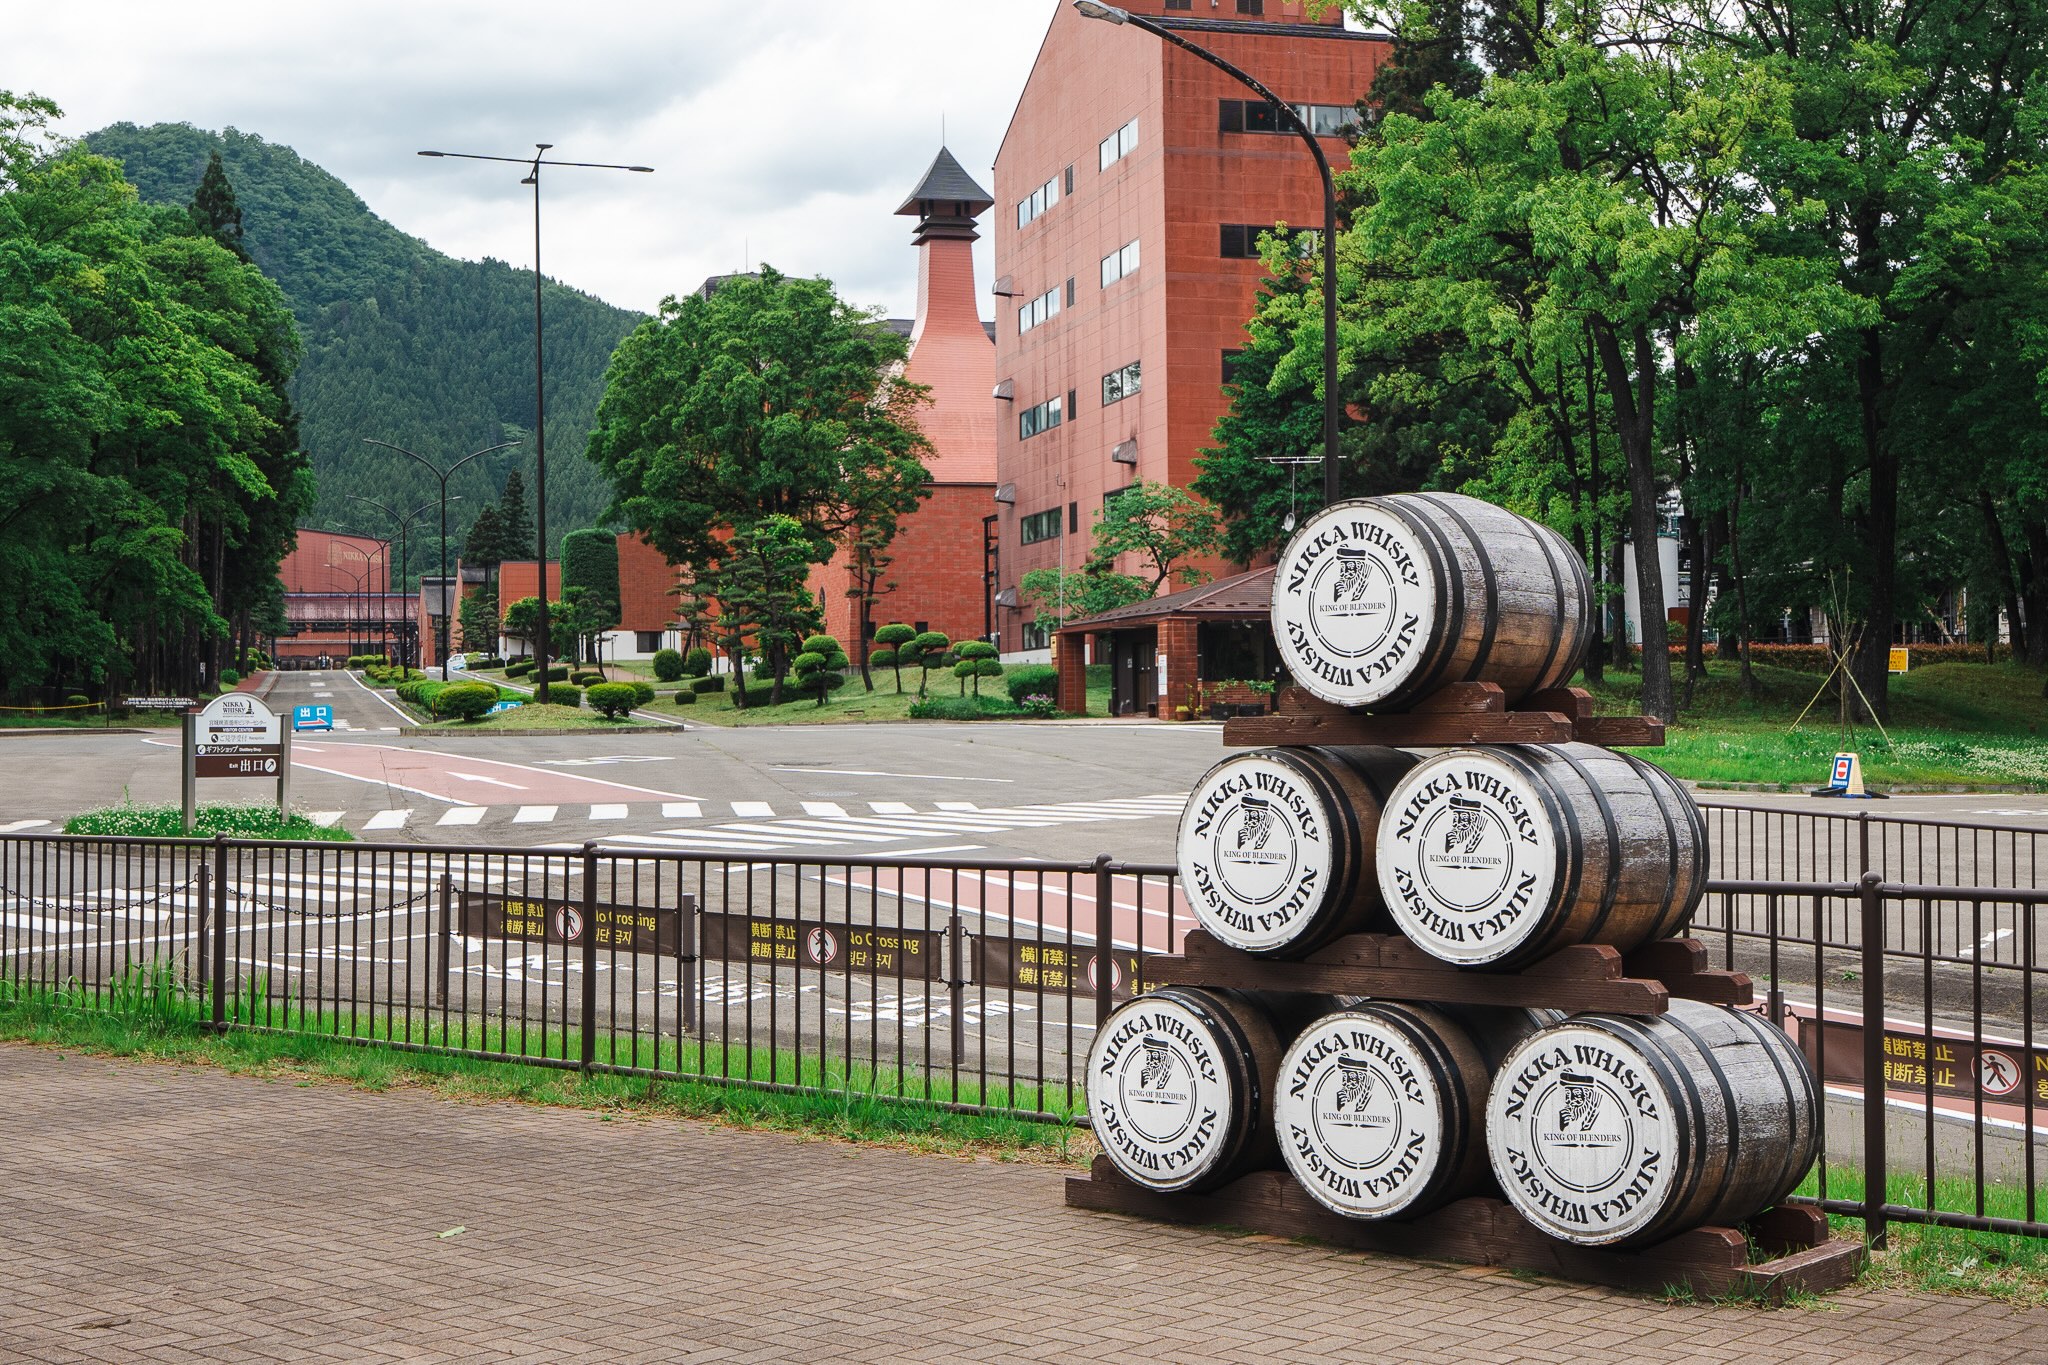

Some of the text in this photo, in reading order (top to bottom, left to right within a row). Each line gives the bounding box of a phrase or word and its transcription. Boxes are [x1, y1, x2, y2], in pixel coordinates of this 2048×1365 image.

[1288, 522, 1419, 596] NIKKA WHISKY
[1350, 602, 1386, 610] BLENDERS
[1287, 612, 1419, 686] NIKKA WHISKY
[301, 707, 326, 717] 出口
[240, 759, 263, 772] 出口
[1195, 772, 1319, 842] NIKKA WHISKY
[1396, 771, 1538, 846] NIKKA WHISKY
[1252, 852, 1286, 860] BLENDERS
[1462, 856, 1502, 864] BLENDERS
[609, 911, 656, 931] rosing
[1193, 862, 1317, 932] NIKKA WHISKY
[1395, 867, 1536, 942] NIKKA WHISKY
[866, 932, 919, 954] Cossng
[1101, 1014, 1217, 1084] NIKKA WHISKY
[1290, 1032, 1425, 1106] NIKKA WHISKY
[1505, 1045, 1659, 1122] NIKKA WHISKY
[1155, 1091, 1187, 1100] BLENDERS
[1353, 1114, 1390, 1123] BLENDERS
[1100, 1100, 1217, 1170] NIKKA WHISKY
[1290, 1124, 1425, 1198] NIKKA WHISKY
[1579, 1134, 1621, 1142] BLENDERS
[1507, 1147, 1661, 1224] NIKKA WHISKY
